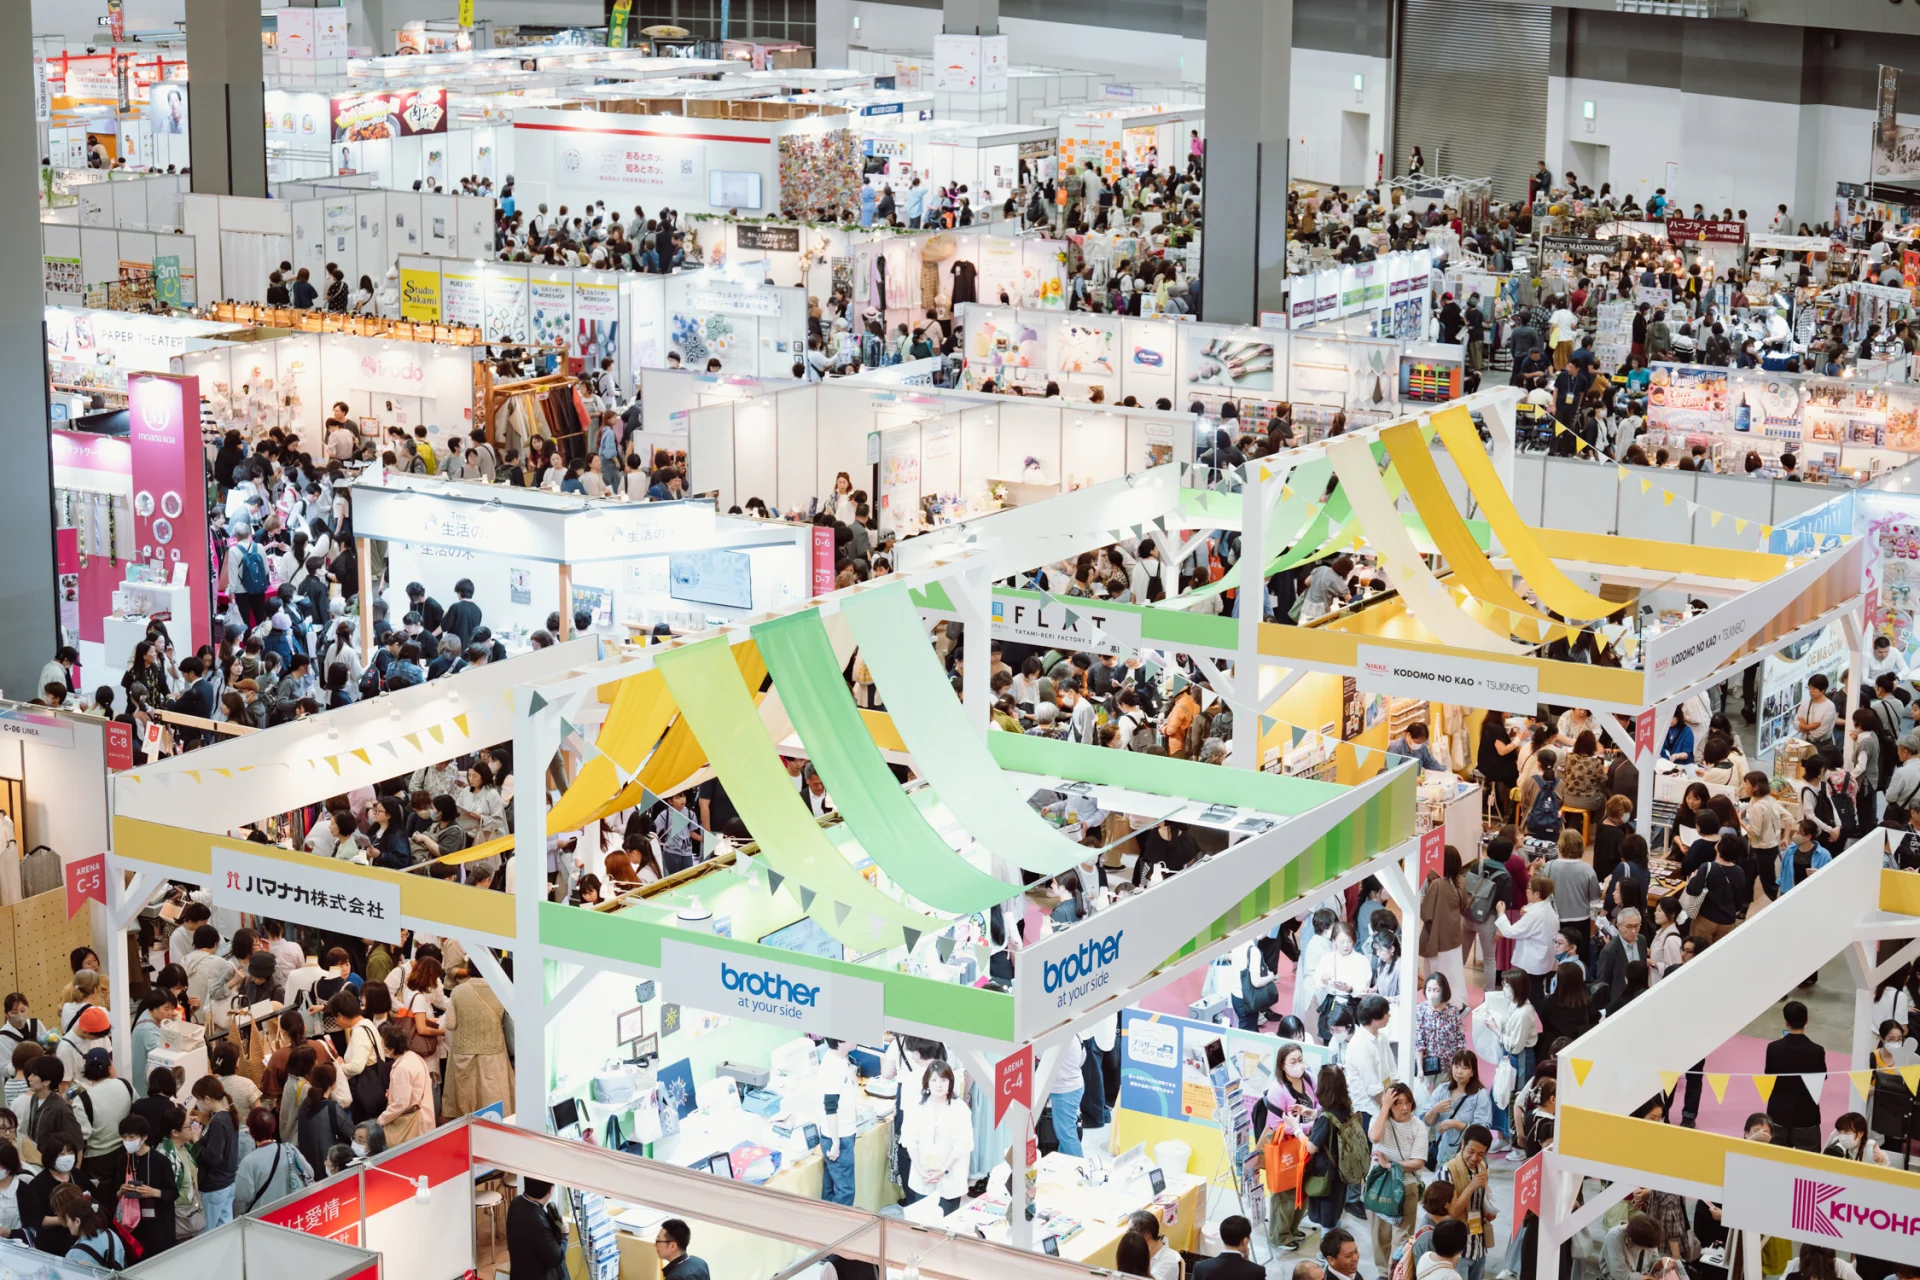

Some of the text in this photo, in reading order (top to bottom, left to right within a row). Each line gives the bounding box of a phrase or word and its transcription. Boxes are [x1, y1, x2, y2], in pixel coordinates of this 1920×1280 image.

[626, 152, 664, 162] あるとホッ。
[626, 163, 664, 174] 知るとホッ。
[1669, 220, 1740, 233] ハーブティー専門店
[1544, 241, 1615, 252] MAGIC MAYONNAISE
[158, 265, 178, 278] 3m
[406, 280, 434, 295] Studio
[403, 289, 437, 305] Sakami
[102, 330, 183, 348] PAPER THEATER
[138, 432, 176, 444] moana koa
[451, 512, 466, 520] Tree
[815, 538, 830, 547] D-6
[816, 575, 830, 584] D-7
[1015, 629, 1054, 639] TATAMI-BERI
[1058, 634, 1086, 644] FACTORY
[1671, 644, 1696, 667] KODOMO
[1696, 641, 1705, 653] NO
[1705, 635, 1717, 649] KAO
[1722, 619, 1746, 641] TSUKINEKO
[1364, 662, 1389, 672] NIKKE
[1394, 668, 1435, 681] KODOMO
[1437, 674, 1452, 683] NO
[1454, 676, 1475, 687] KAO
[1486, 680, 1530, 695] TSUKINEKO
[4, 724, 39, 736] C-06 LINEA
[1640, 729, 1651, 741] D-4
[110, 736, 127, 748] C-8
[1426, 834, 1440, 848] ARENA
[1425, 845, 1439, 864] C-4
[76, 862, 100, 876] ARENA
[77, 874, 100, 894] C-5
[246, 875, 385, 920] ハマナカ株式会社
[1043, 929, 1123, 994] brother
[722, 962, 821, 1007] brother
[1057, 970, 1109, 1008] at your side
[738, 997, 802, 1019] at your side
[1003, 1058, 1024, 1076] ARENA
[1003, 1071, 1024, 1095] C-4
[1521, 1164, 1539, 1185] ARENA
[1521, 1179, 1537, 1205] C-3
